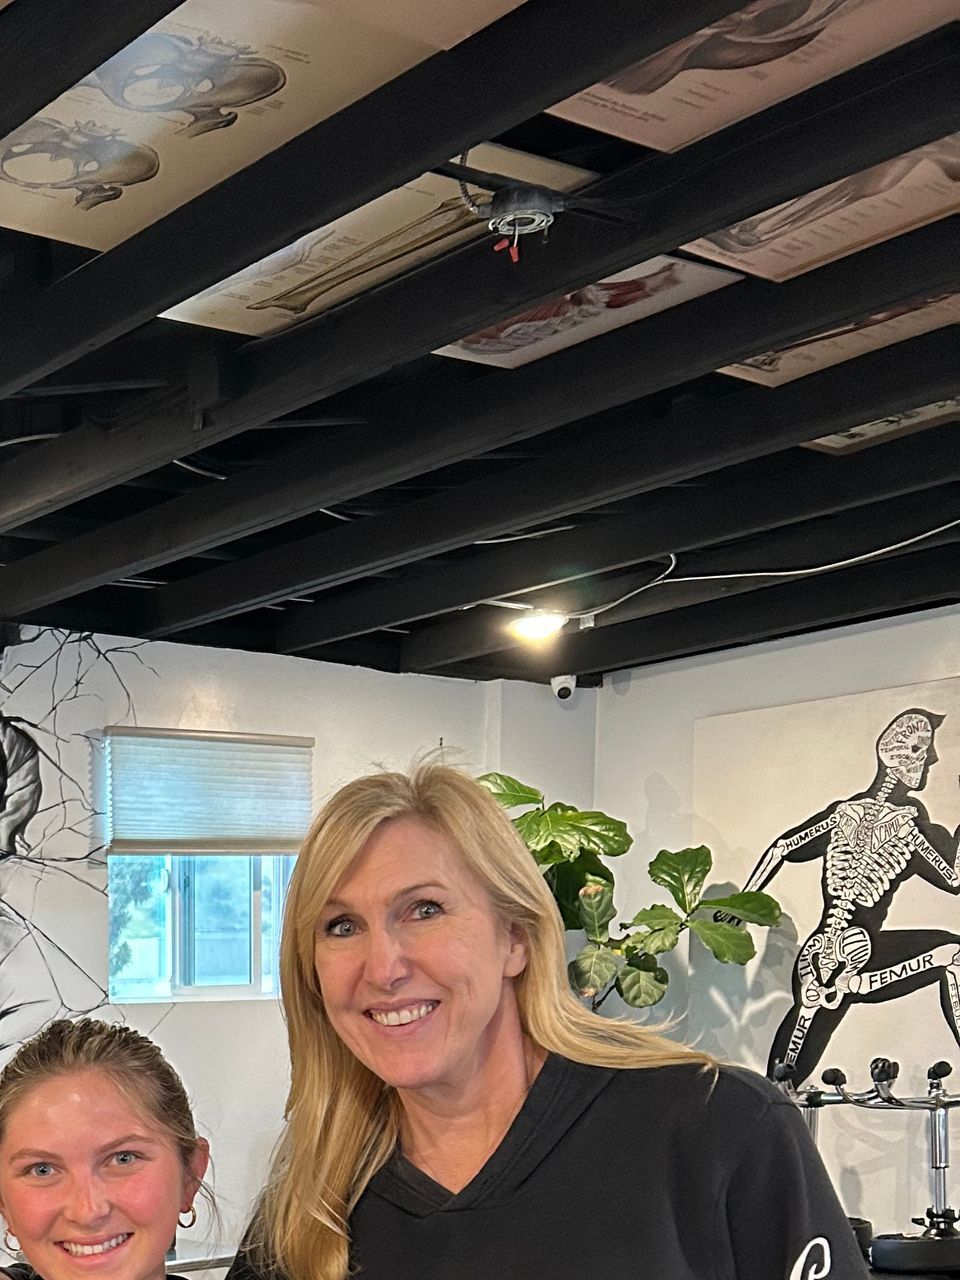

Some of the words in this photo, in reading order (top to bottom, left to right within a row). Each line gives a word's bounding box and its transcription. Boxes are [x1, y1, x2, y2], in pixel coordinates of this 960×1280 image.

[785, 815, 839, 851] HUMERUS
[908, 827, 955, 881] HUMERUS
[868, 953, 934, 990] FEMUR
[785, 1014, 812, 1064] EMUR
